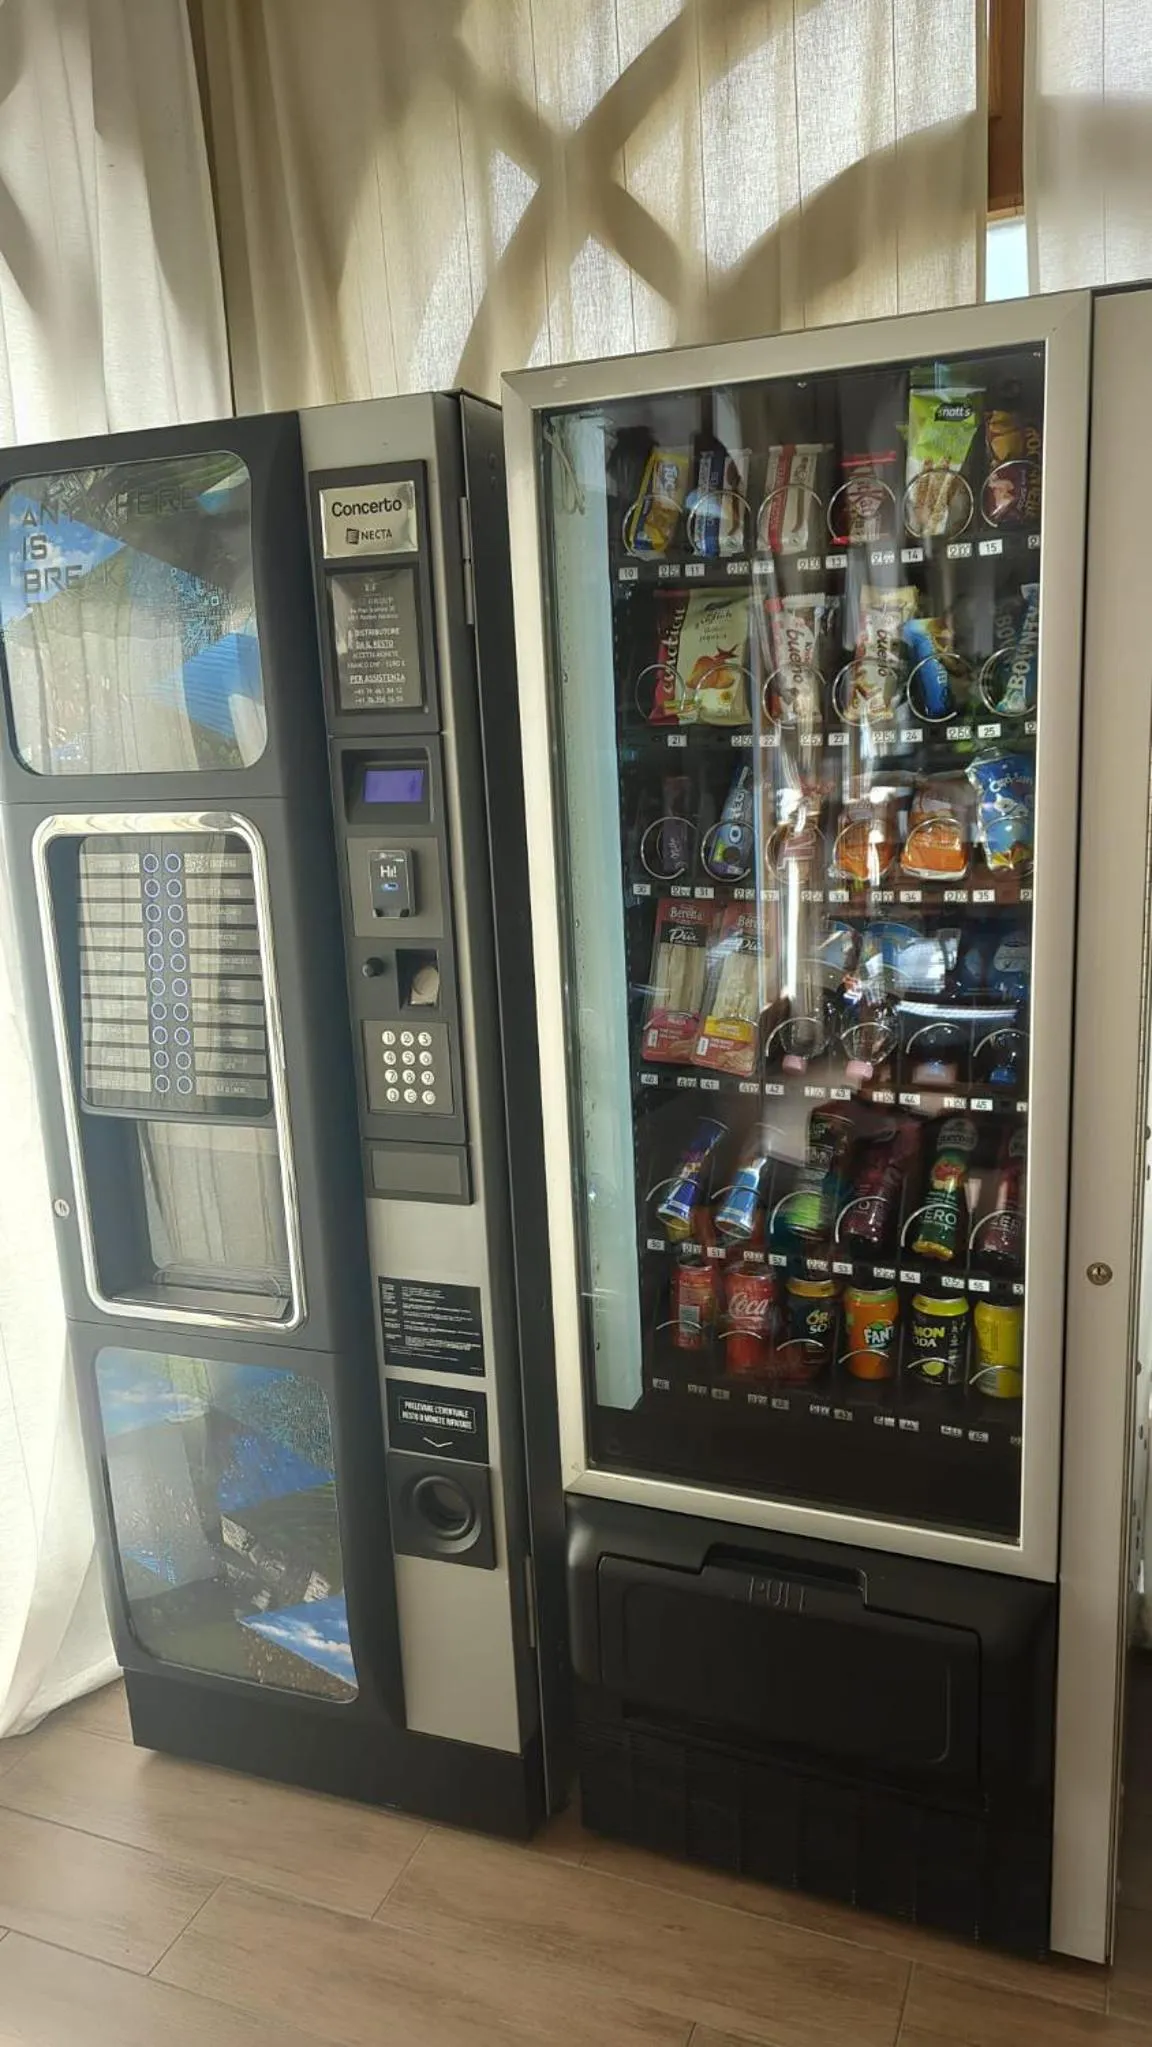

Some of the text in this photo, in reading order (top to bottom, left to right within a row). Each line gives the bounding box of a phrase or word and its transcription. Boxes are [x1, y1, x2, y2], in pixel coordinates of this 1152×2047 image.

[331, 498, 402, 518] Concerto
[360, 528, 393, 542] NECTA
[22, 534, 48, 563] IS
[786, 628, 805, 684] bueno
[380, 865, 397, 878] Hi!
[728, 1291, 769, 1319] Coca
